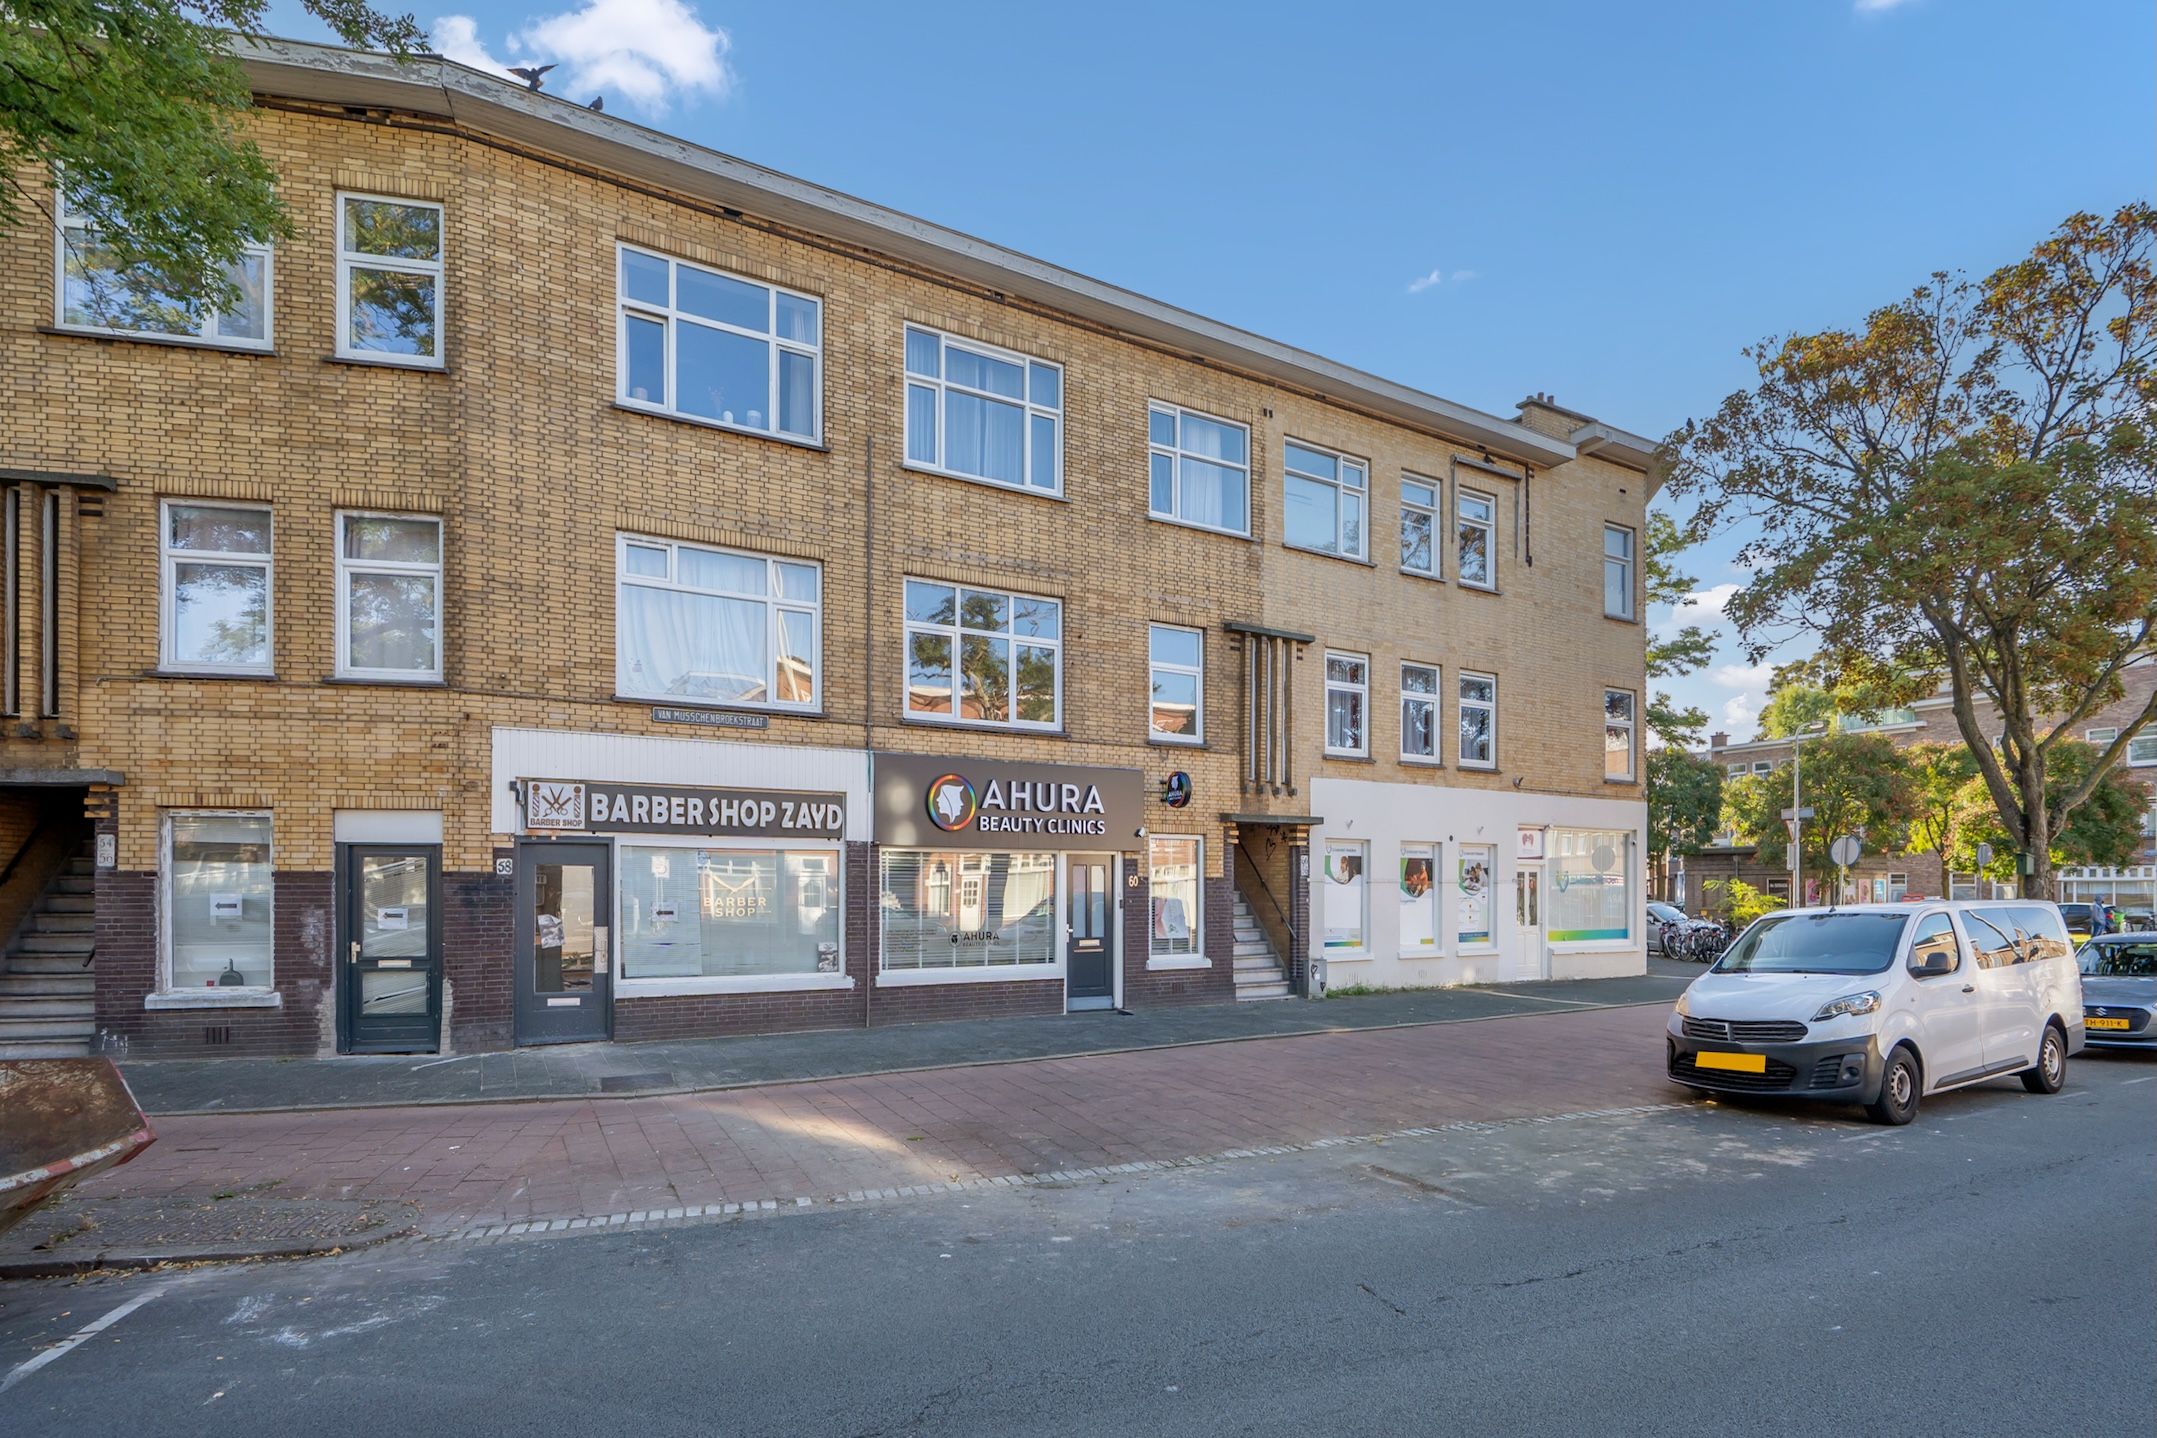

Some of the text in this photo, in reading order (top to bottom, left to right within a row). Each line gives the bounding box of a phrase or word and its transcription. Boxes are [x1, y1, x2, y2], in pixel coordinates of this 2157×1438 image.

[657, 709, 764, 727] VAN MUSSCHENBROEKSTRAAT
[980, 779, 1105, 814] AHURA
[590, 792, 843, 830] BARBER SHOP ZAYD
[530, 817, 583, 827] BARBER SHOP
[979, 815, 1106, 835] BEAUTY CLINICS
[497, 860, 512, 873] 58
[1128, 875, 1139, 887] 60
[703, 896, 767, 907] BARBER
[715, 907, 756, 917] SHOP
[963, 931, 1000, 941] AHURA
